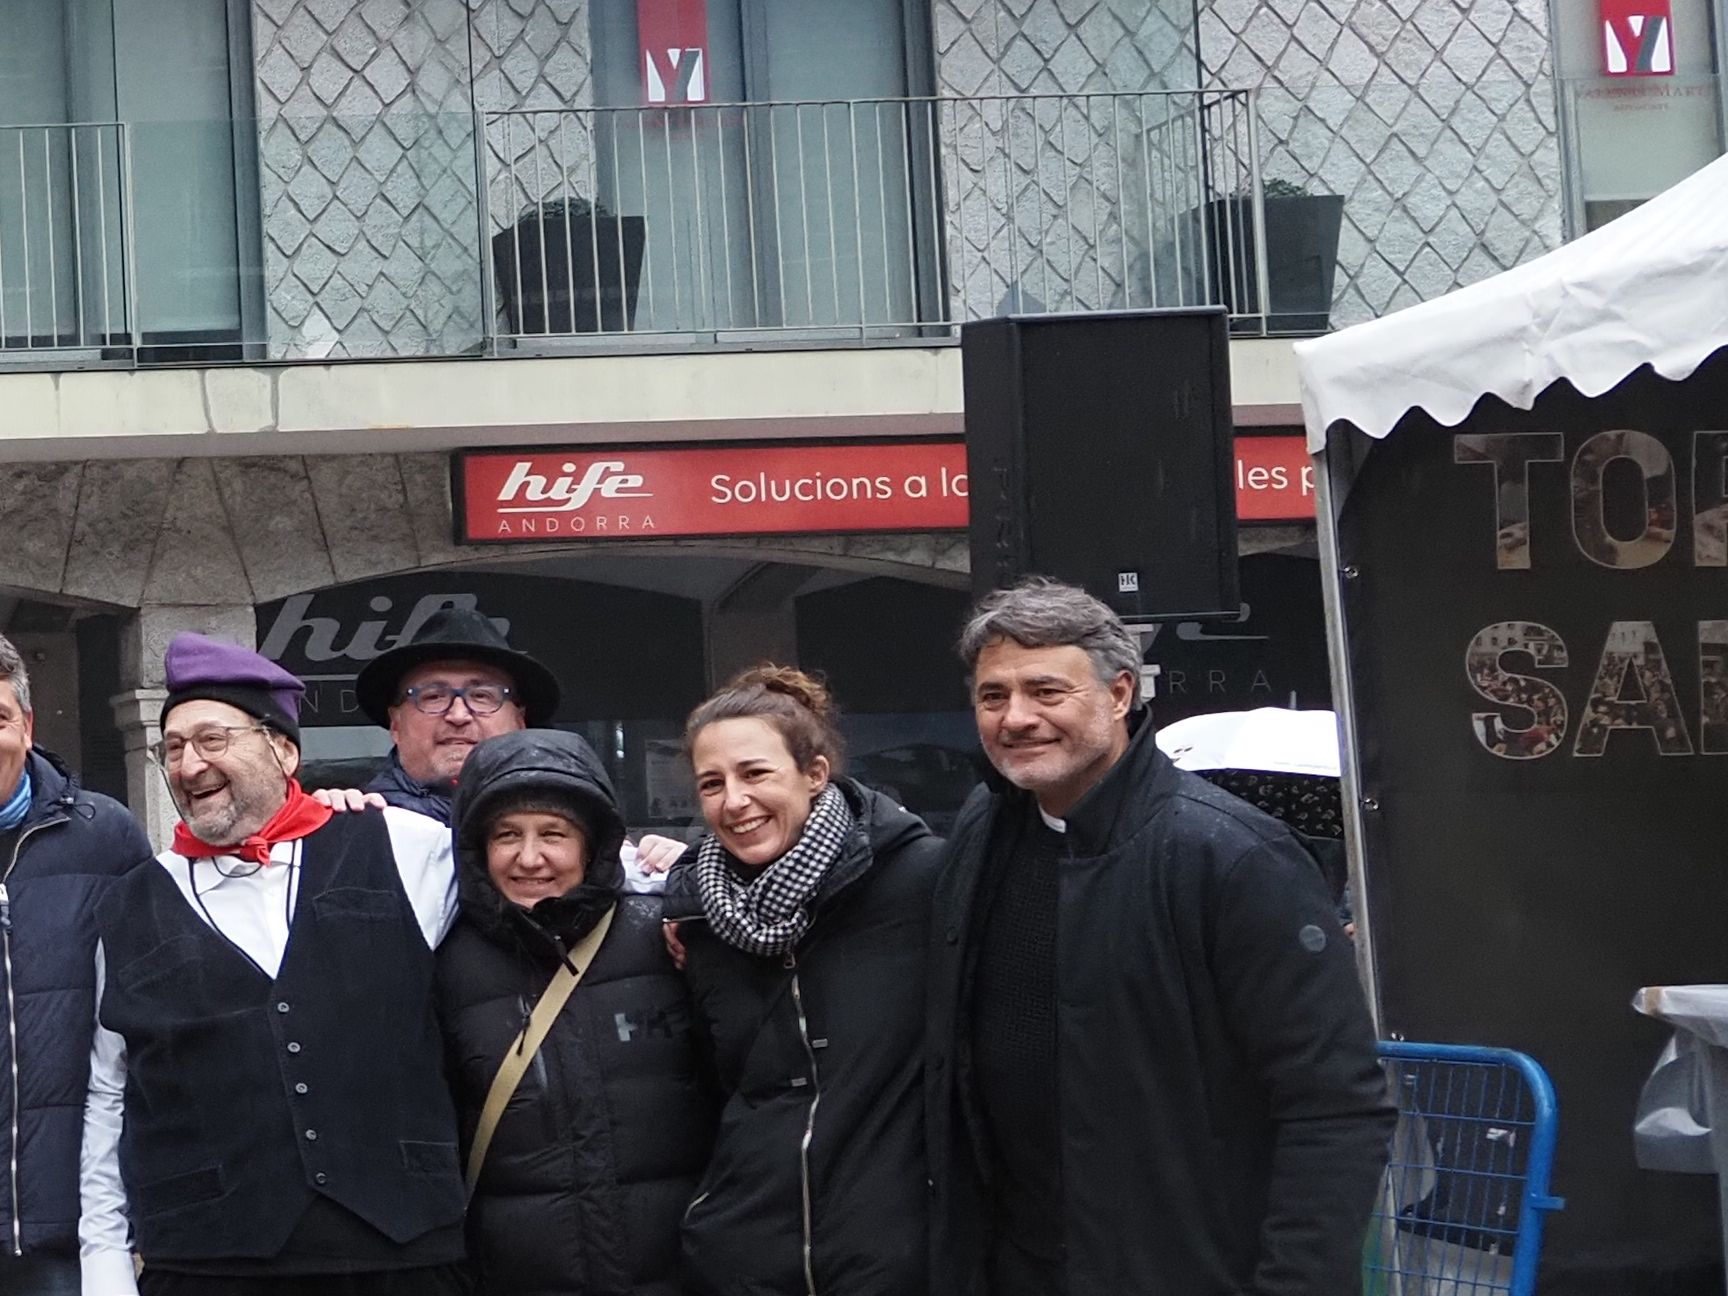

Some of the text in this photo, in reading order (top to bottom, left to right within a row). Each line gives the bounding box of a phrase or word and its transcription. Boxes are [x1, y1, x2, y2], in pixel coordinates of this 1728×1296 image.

[497, 461, 654, 513] hife
[711, 472, 893, 504] Solucions
[903, 475, 928, 498] a
[1237, 459, 1288, 490] les
[498, 515, 655, 534] ANDORRA
[259, 593, 529, 663] hif
